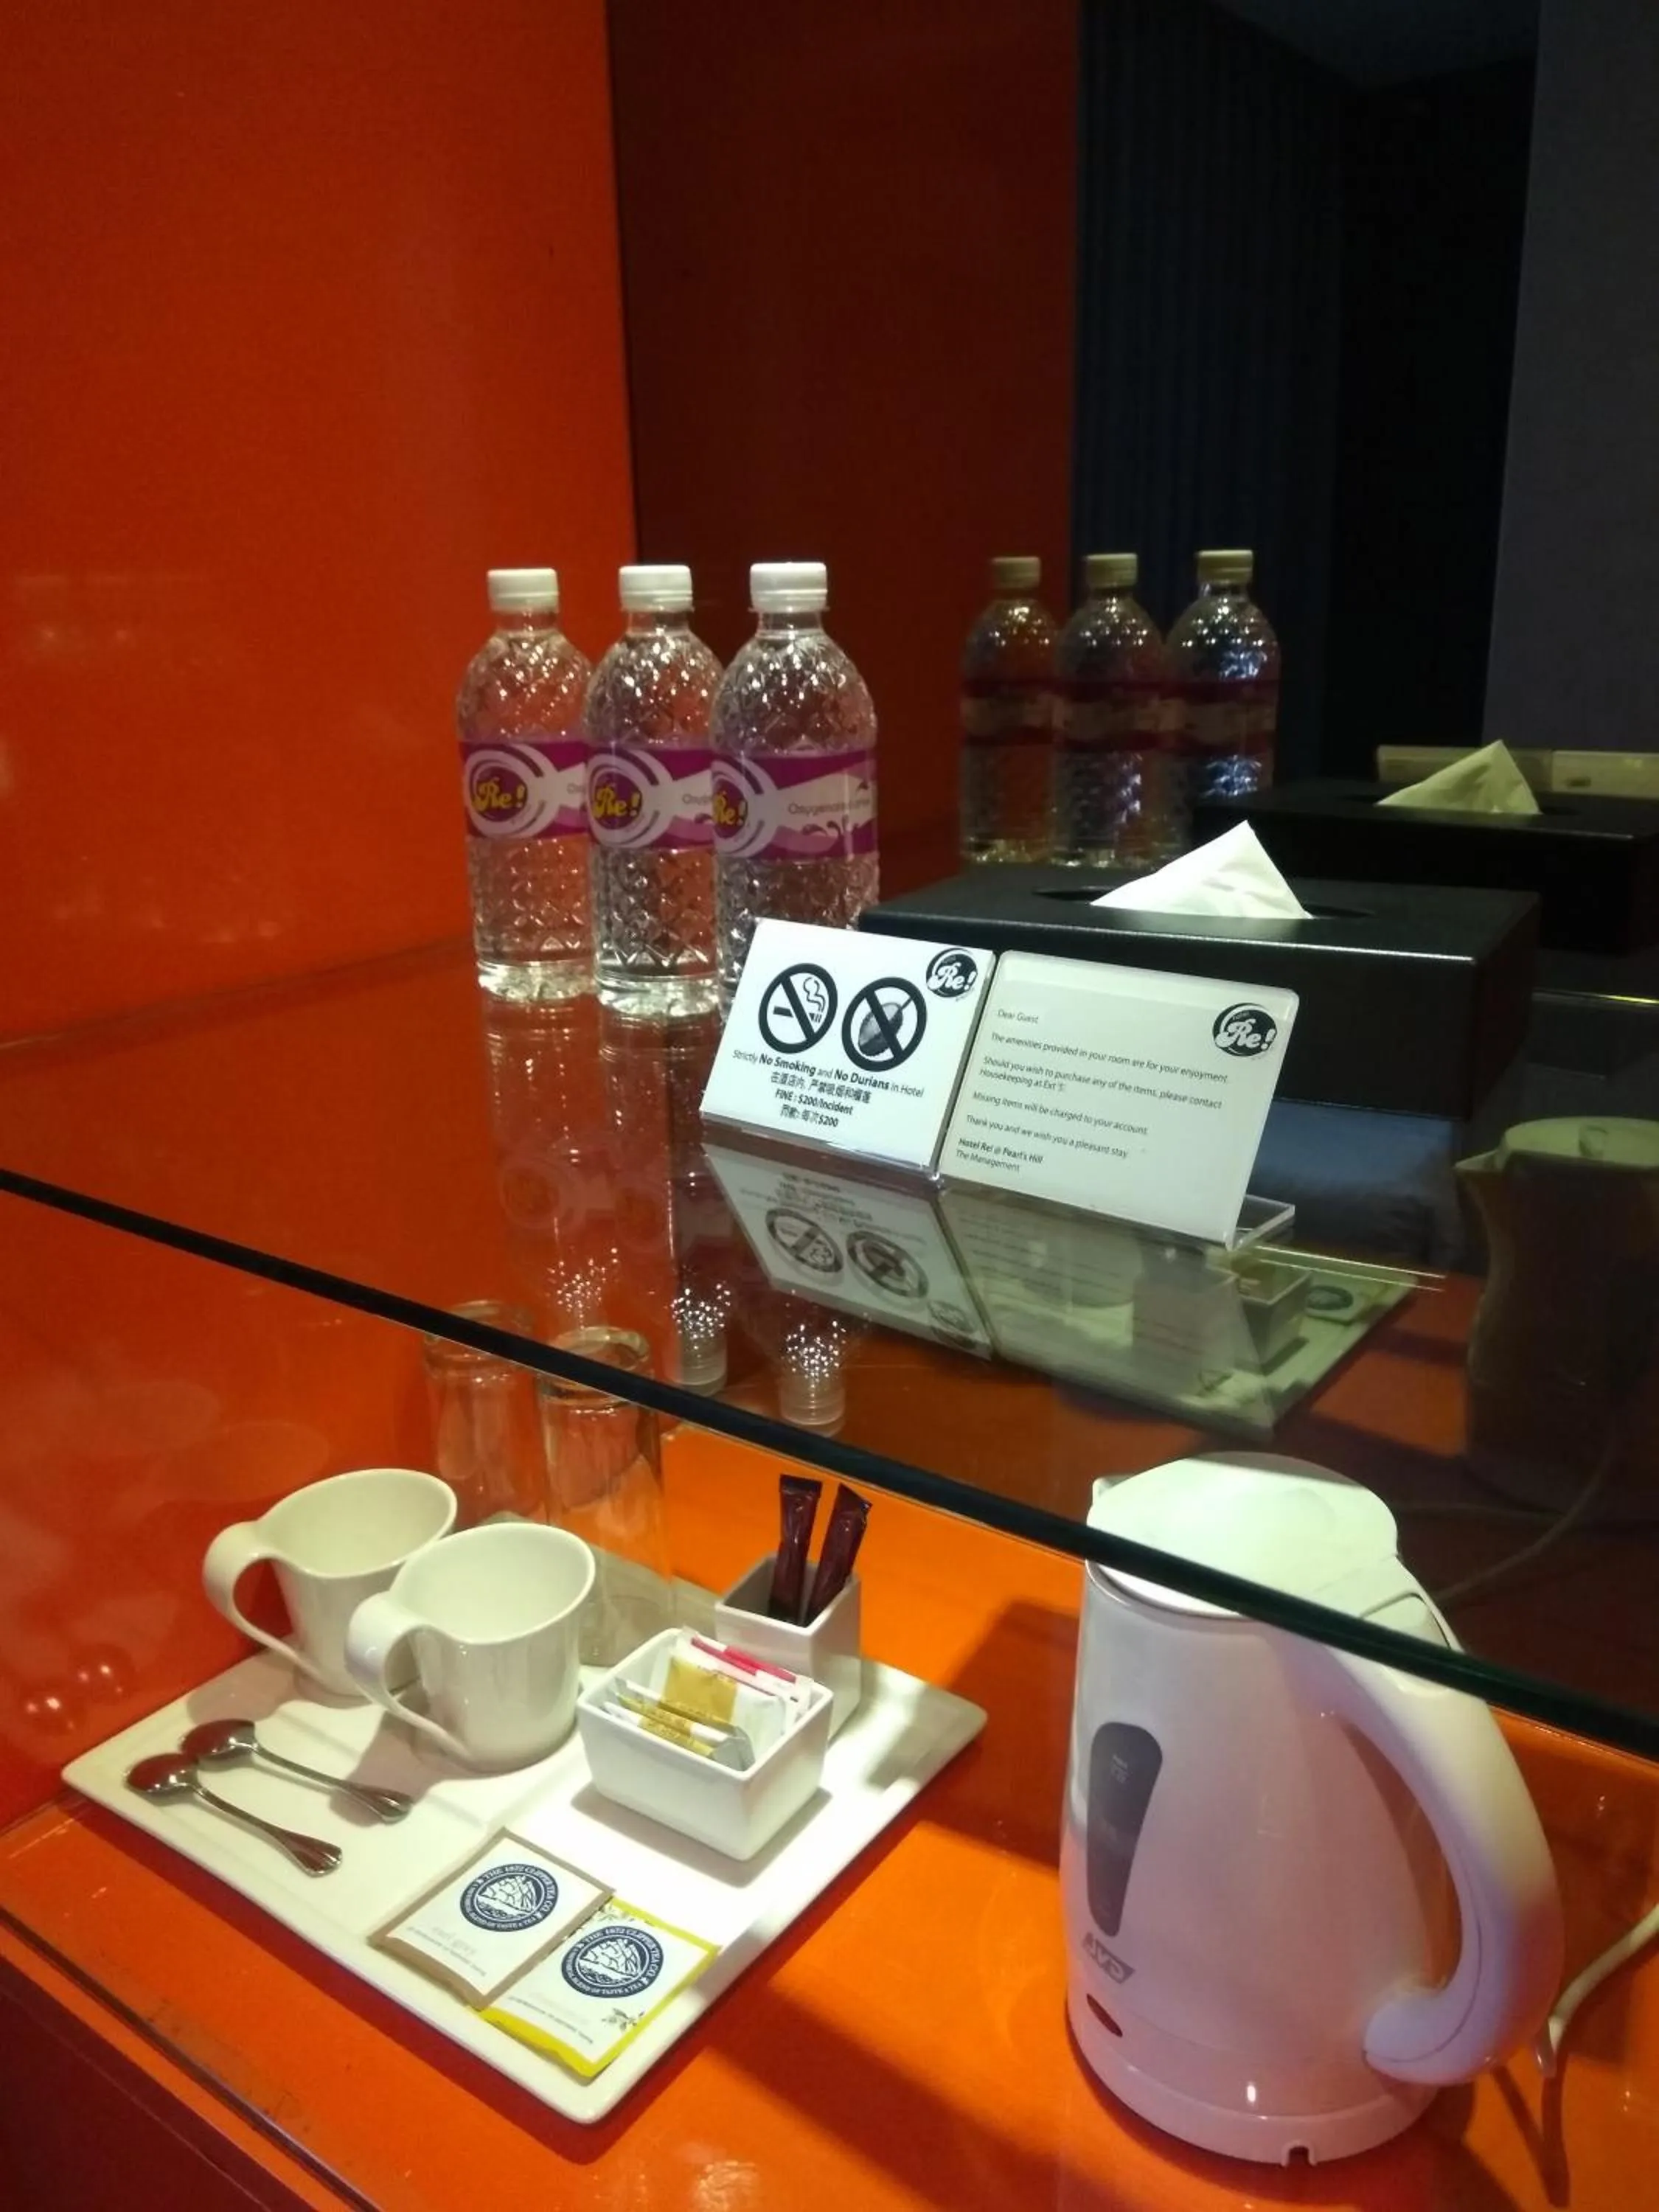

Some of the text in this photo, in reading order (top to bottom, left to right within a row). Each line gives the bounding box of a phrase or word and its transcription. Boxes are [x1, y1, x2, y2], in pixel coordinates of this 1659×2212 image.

[471, 776, 526, 812] Re!
[593, 782, 640, 818] Re!
[928, 961, 977, 990] Re!
[998, 1008, 1015, 1020] Dear
[1215, 1018, 1276, 1050] Re!
[992, 1032, 1005, 1043] The
[1005, 1036, 1042, 1050] amenities
[1042, 1043, 1079, 1057] provided
[1079, 1048, 1088, 1057] in
[1088, 1051, 1107, 1061] your
[1107, 1054, 1130, 1065] room
[1132, 1060, 1145, 1068] are
[1146, 1060, 1158, 1070] for
[1159, 1065, 1180, 1074] your
[732, 1049, 925, 1097] Strictly No Smoking and No Durians in Hotel
[979, 1068, 1033, 1088] Housekeeping
[1034, 1079, 1043, 1087] at
[984, 1054, 1009, 1069] Should
[1010, 1062, 1026, 1072] you
[1026, 1065, 1043, 1076] wish
[1045, 1068, 1054, 1077] to
[1054, 1071, 1091, 1085] purchase
[1091, 1077, 1107, 1088] any
[1108, 1079, 1118, 1088] of
[1119, 1082, 1133, 1092] the
[1159, 1089, 1188, 1102] please
[1189, 1096, 1222, 1109] contact
[973, 1091, 1001, 1107] Missing
[1002, 1097, 1023, 1109] items
[1024, 1102, 1038, 1112] will
[1038, 1104, 1048, 1115] be
[1049, 1108, 1083, 1121] charged
[1083, 1114, 1093, 1124] to
[1093, 1118, 1113, 1128] your
[959, 1138, 981, 1150] Hotel
[1029, 1153, 1044, 1164] Hill
[967, 1113, 987, 1126] Thank
[989, 1121, 1004, 1130] you
[1004, 1124, 1020, 1134] and
[1021, 1129, 1033, 1137] we
[1033, 1132, 1052, 1141] wish
[1051, 1136, 1068, 1146] you
[1074, 1140, 1110, 1155] pleasant
[1111, 1147, 1128, 1160] stay
[956, 1148, 1020, 1172] The Management
